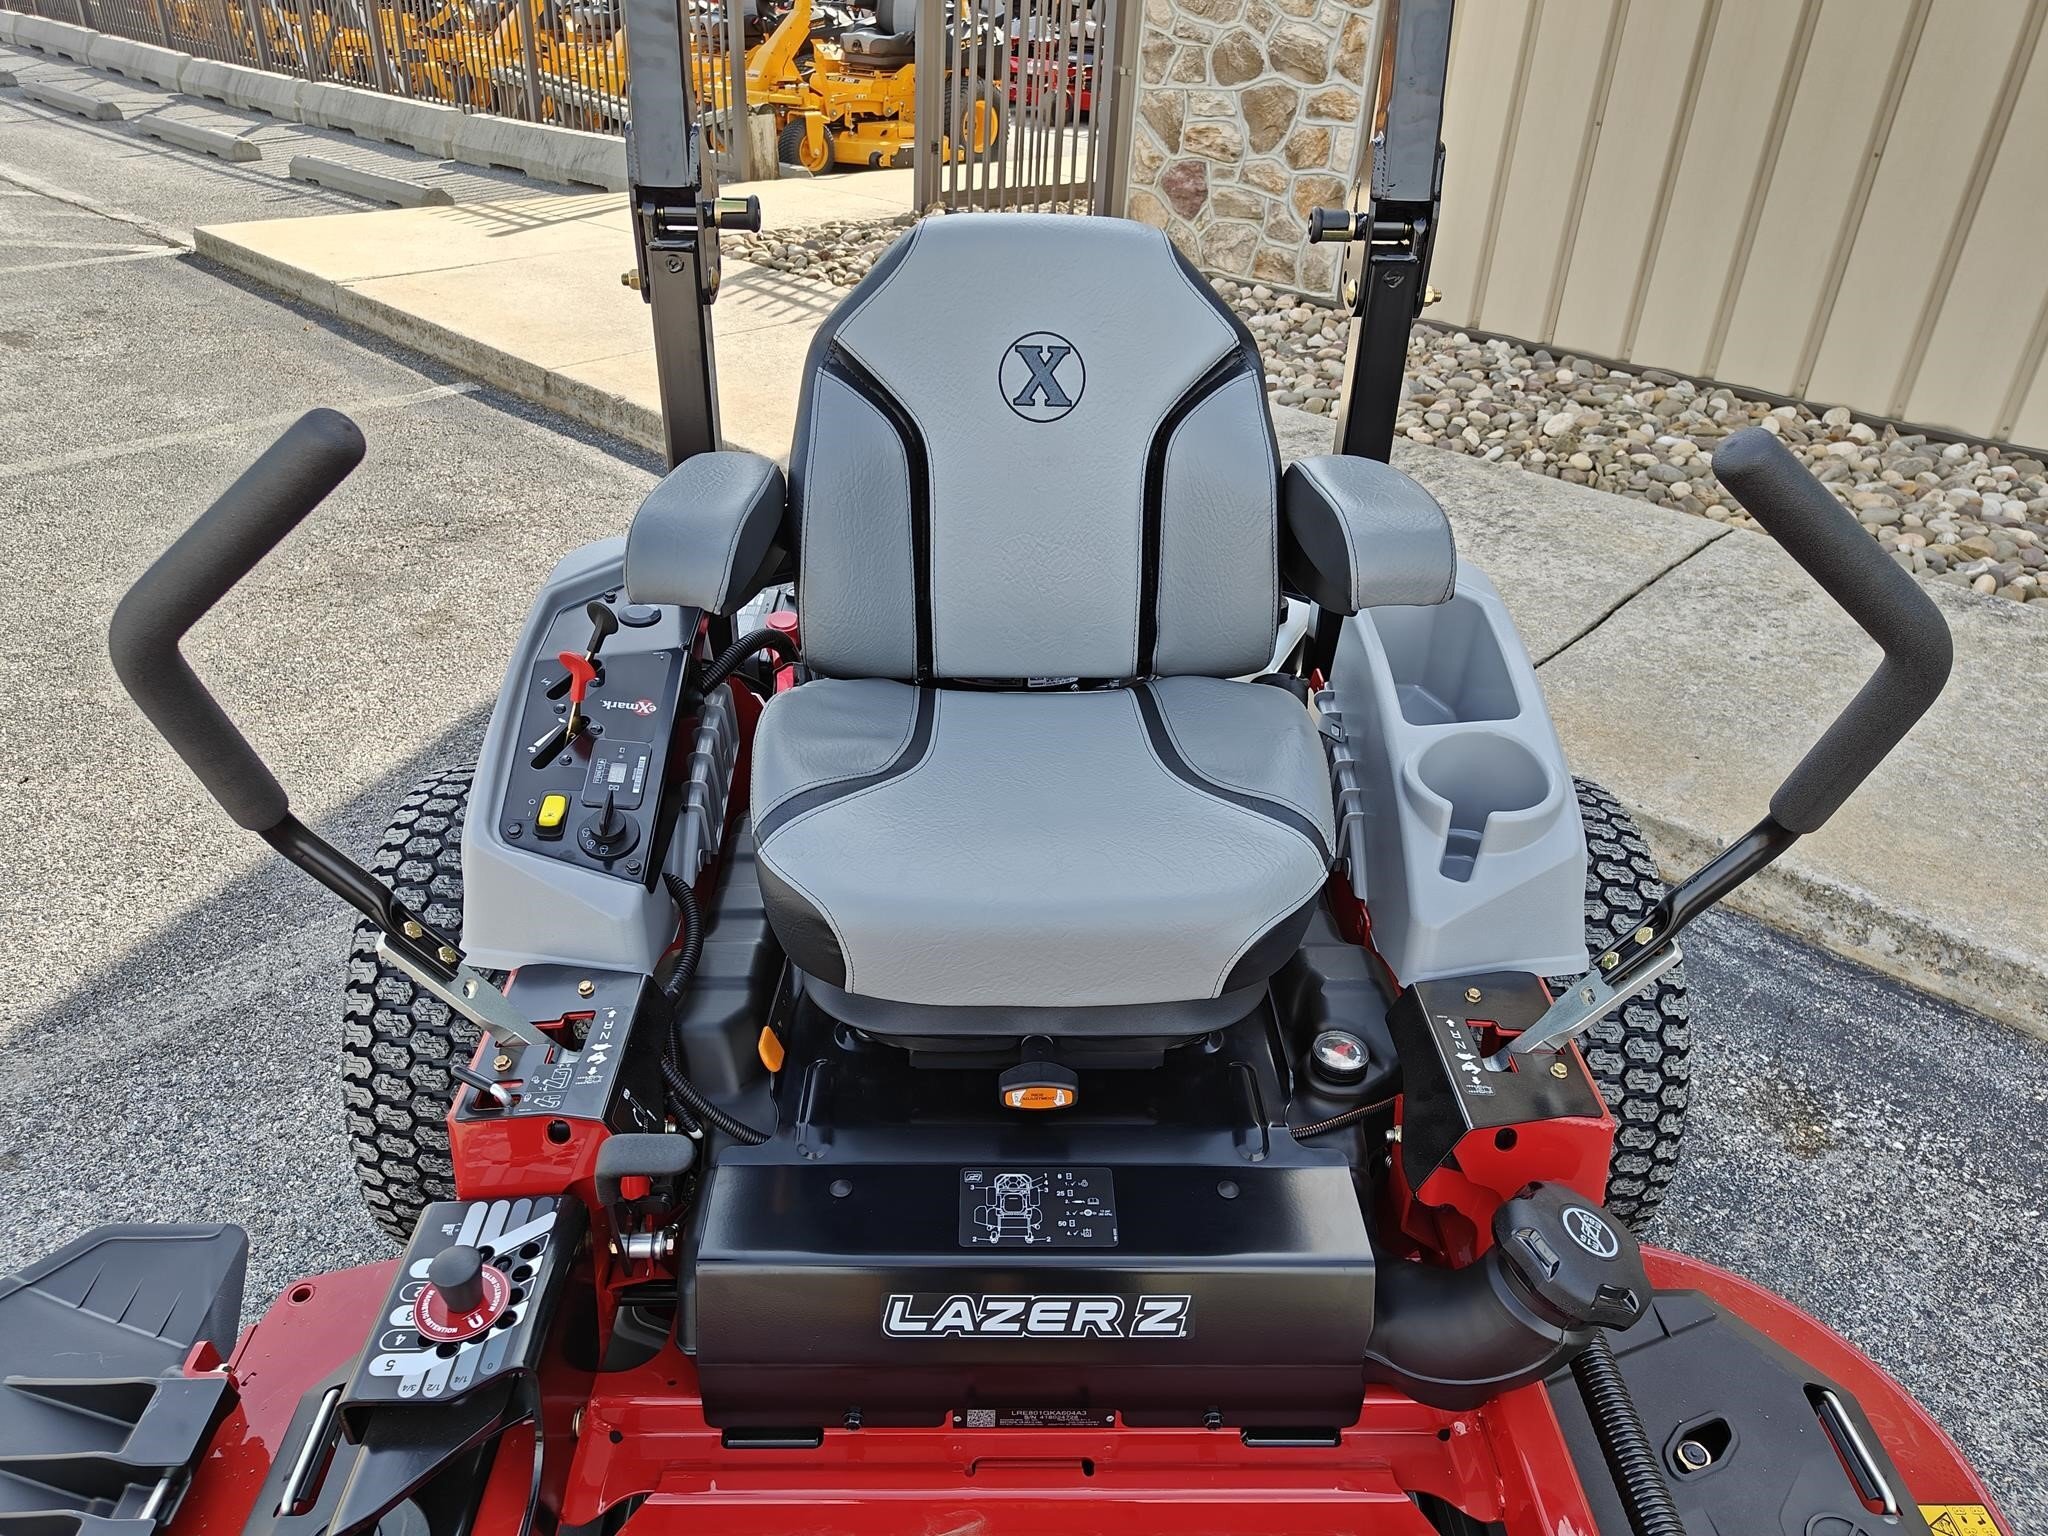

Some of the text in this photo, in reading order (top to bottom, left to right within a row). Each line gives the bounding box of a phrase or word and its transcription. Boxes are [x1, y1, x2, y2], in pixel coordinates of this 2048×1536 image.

[1013, 344, 1072, 408] X
[604, 1021, 614, 1029] R
[600, 1032, 610, 1040] N
[1450, 1030, 1461, 1039] R
[1455, 1041, 1467, 1050] N
[1580, 1234, 1600, 1251] E15
[421, 1290, 458, 1333] MAGNETIC RETENTION
[884, 1296, 1190, 1336] LAZER Z
[395, 1334, 406, 1346] 4
[385, 1359, 396, 1371] 5
[454, 1375, 467, 1384] 1/4
[402, 1383, 417, 1392] 3/4
[427, 1383, 441, 1392] 1/2
